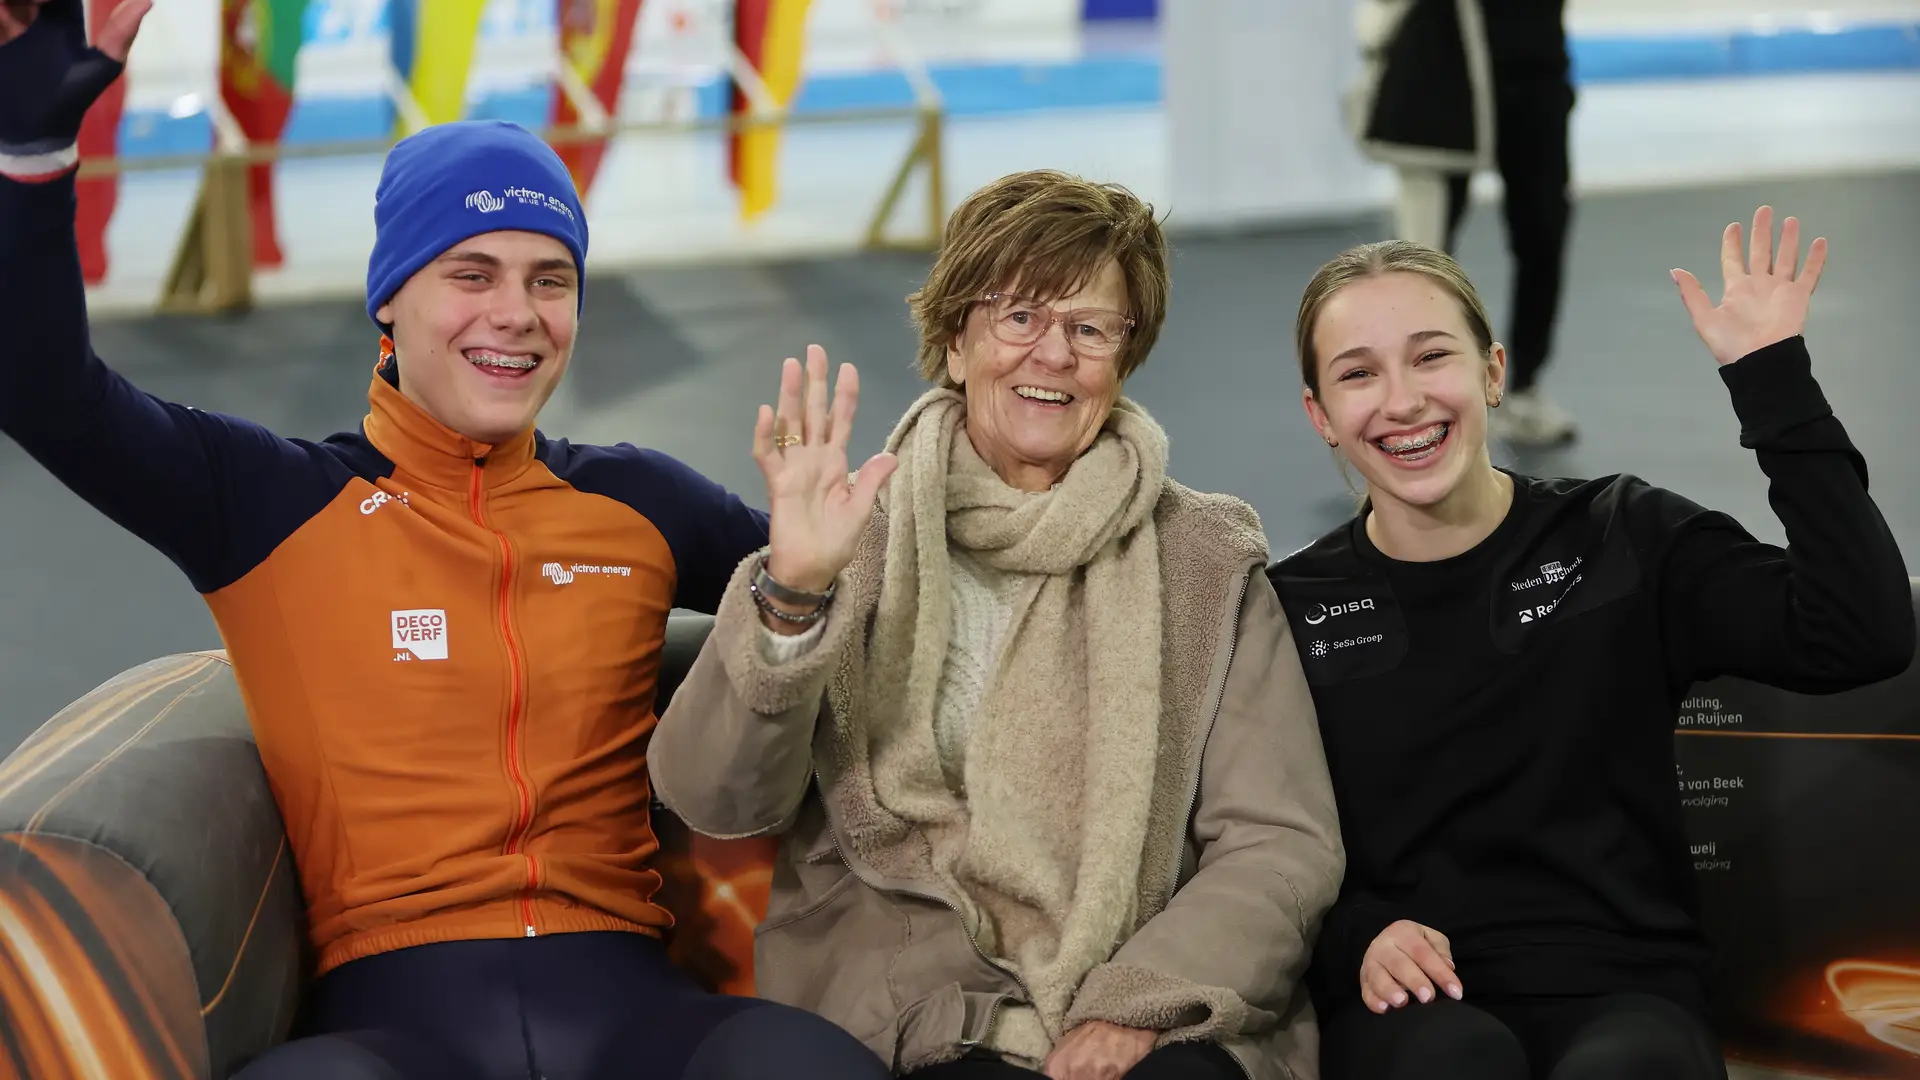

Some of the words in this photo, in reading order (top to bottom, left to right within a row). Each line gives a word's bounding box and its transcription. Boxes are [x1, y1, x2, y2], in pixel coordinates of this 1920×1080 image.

[504, 186, 545, 201] victron
[549, 196, 576, 221] energy
[519, 197, 539, 206] BLUE
[571, 563, 600, 573] victron
[602, 566, 632, 577] energy
[1511, 576, 1543, 592] Steden
[1330, 598, 1375, 617] DISQ
[396, 615, 442, 629] DECO
[396, 628, 442, 642] VERF
[1333, 639, 1355, 650] SeSa
[1356, 633, 1383, 645] Groep
[393, 652, 411, 662] .NL
[1678, 715, 1694, 725] an
[1697, 712, 1743, 726] Ruijven
[1687, 780, 1710, 790] van
[1713, 776, 1744, 789] Beek
[1681, 795, 1729, 807] rvolging
[1690, 841, 1716, 856] weij
[1693, 859, 1732, 871] olging
